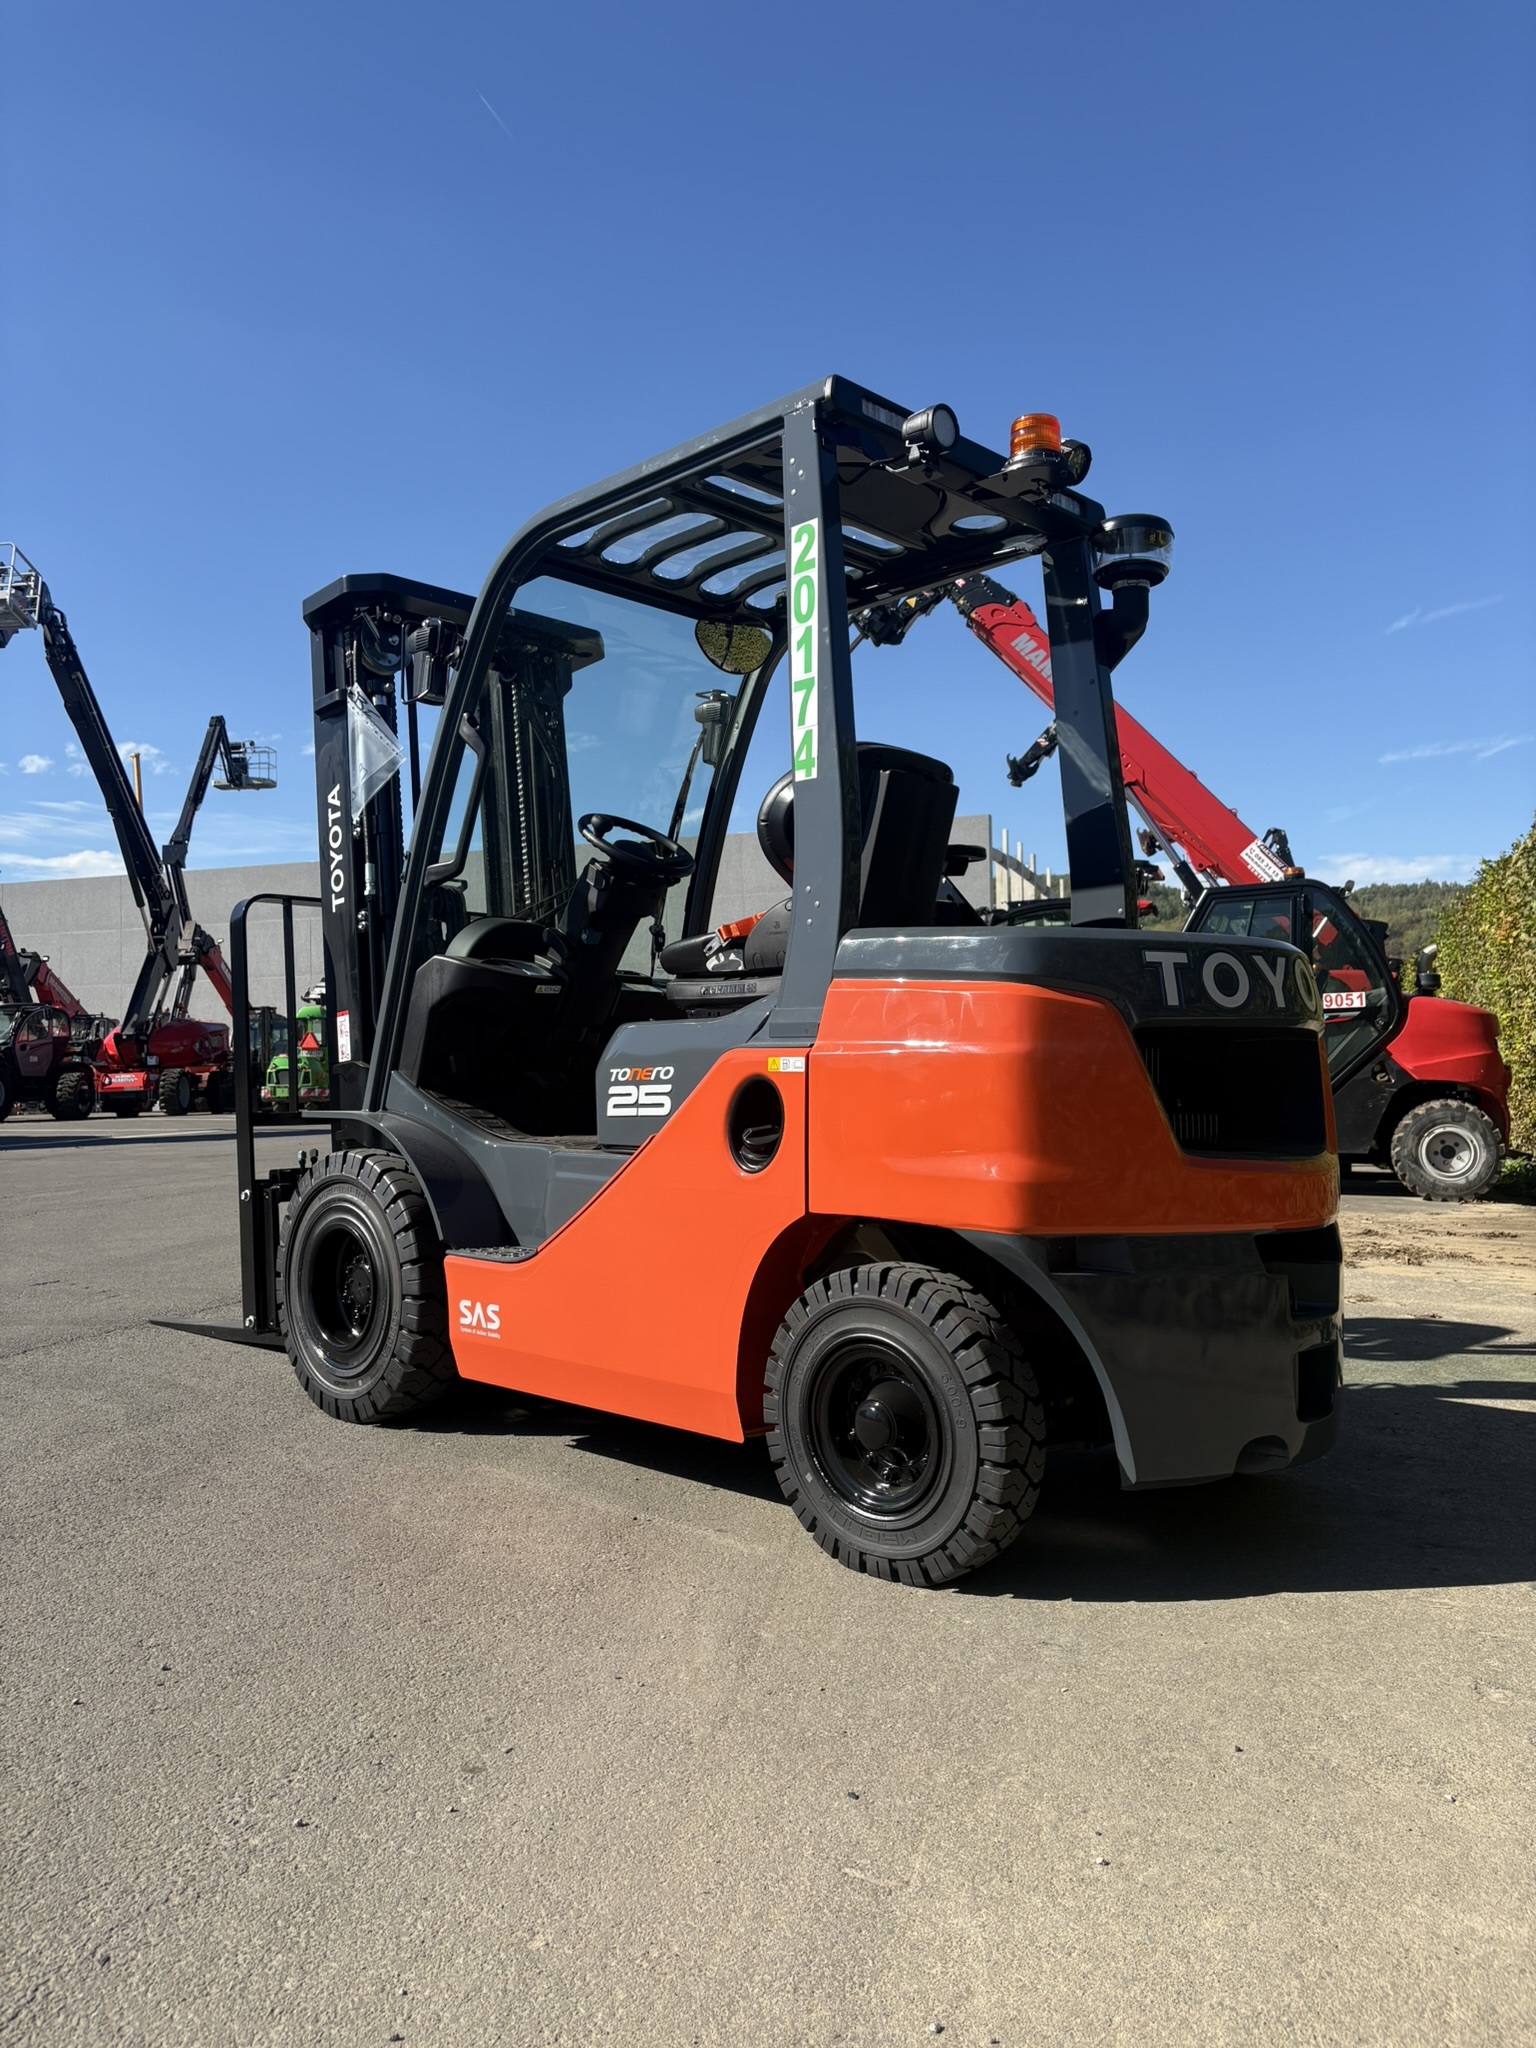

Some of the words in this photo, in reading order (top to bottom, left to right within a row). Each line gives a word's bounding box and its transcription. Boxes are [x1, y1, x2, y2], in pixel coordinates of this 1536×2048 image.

[793, 523, 816, 778] 20174
[1010, 632, 1054, 684] MAN
[328, 783, 345, 913] TOYOTA
[1144, 951, 1317, 1012] TOYO
[1324, 993, 1364, 1008] 9051
[606, 1084, 672, 1116] 25
[459, 1299, 501, 1330] SAS
